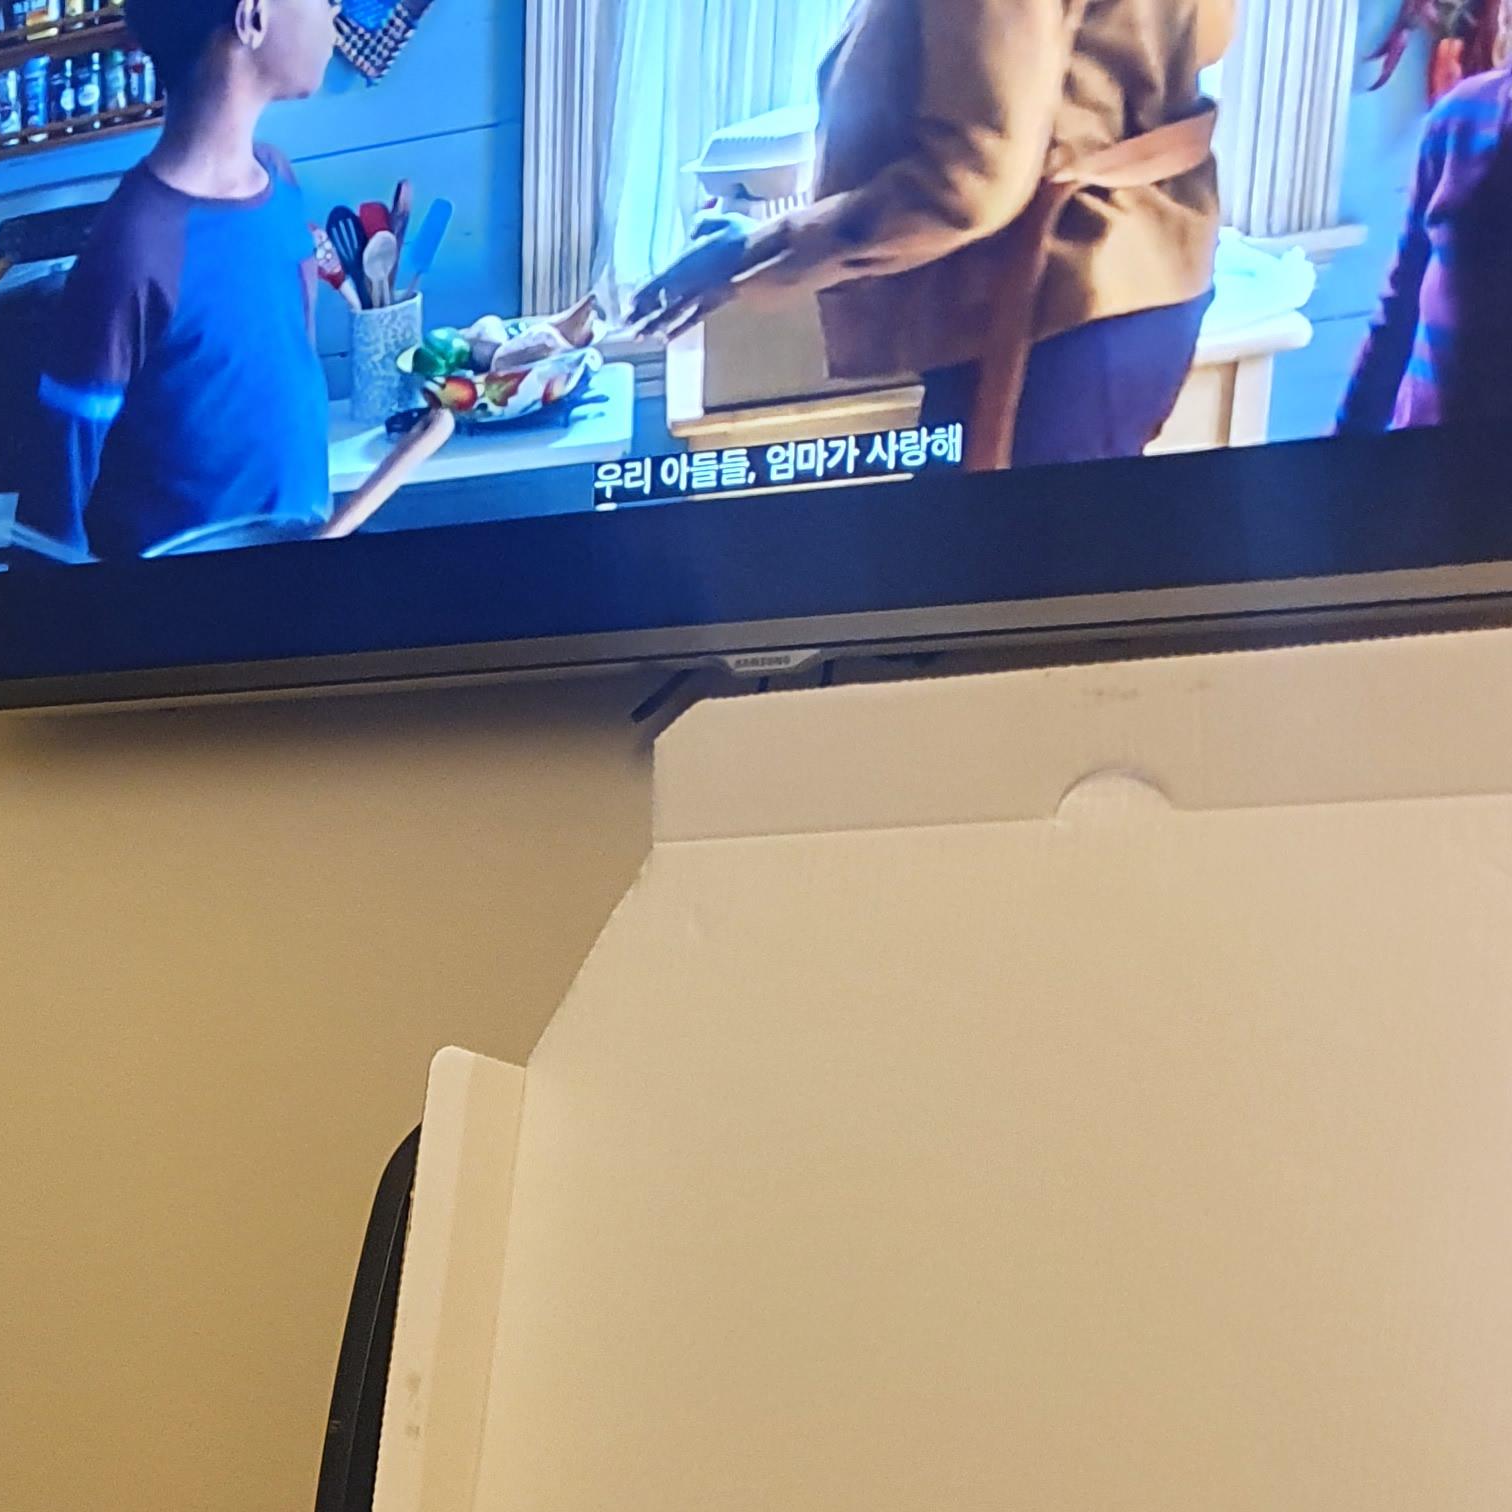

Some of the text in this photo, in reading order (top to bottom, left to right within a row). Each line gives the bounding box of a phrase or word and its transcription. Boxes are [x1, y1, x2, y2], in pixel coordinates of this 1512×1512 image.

[594, 423, 963, 498] 우리 아들들, 엄마가 사랑해
